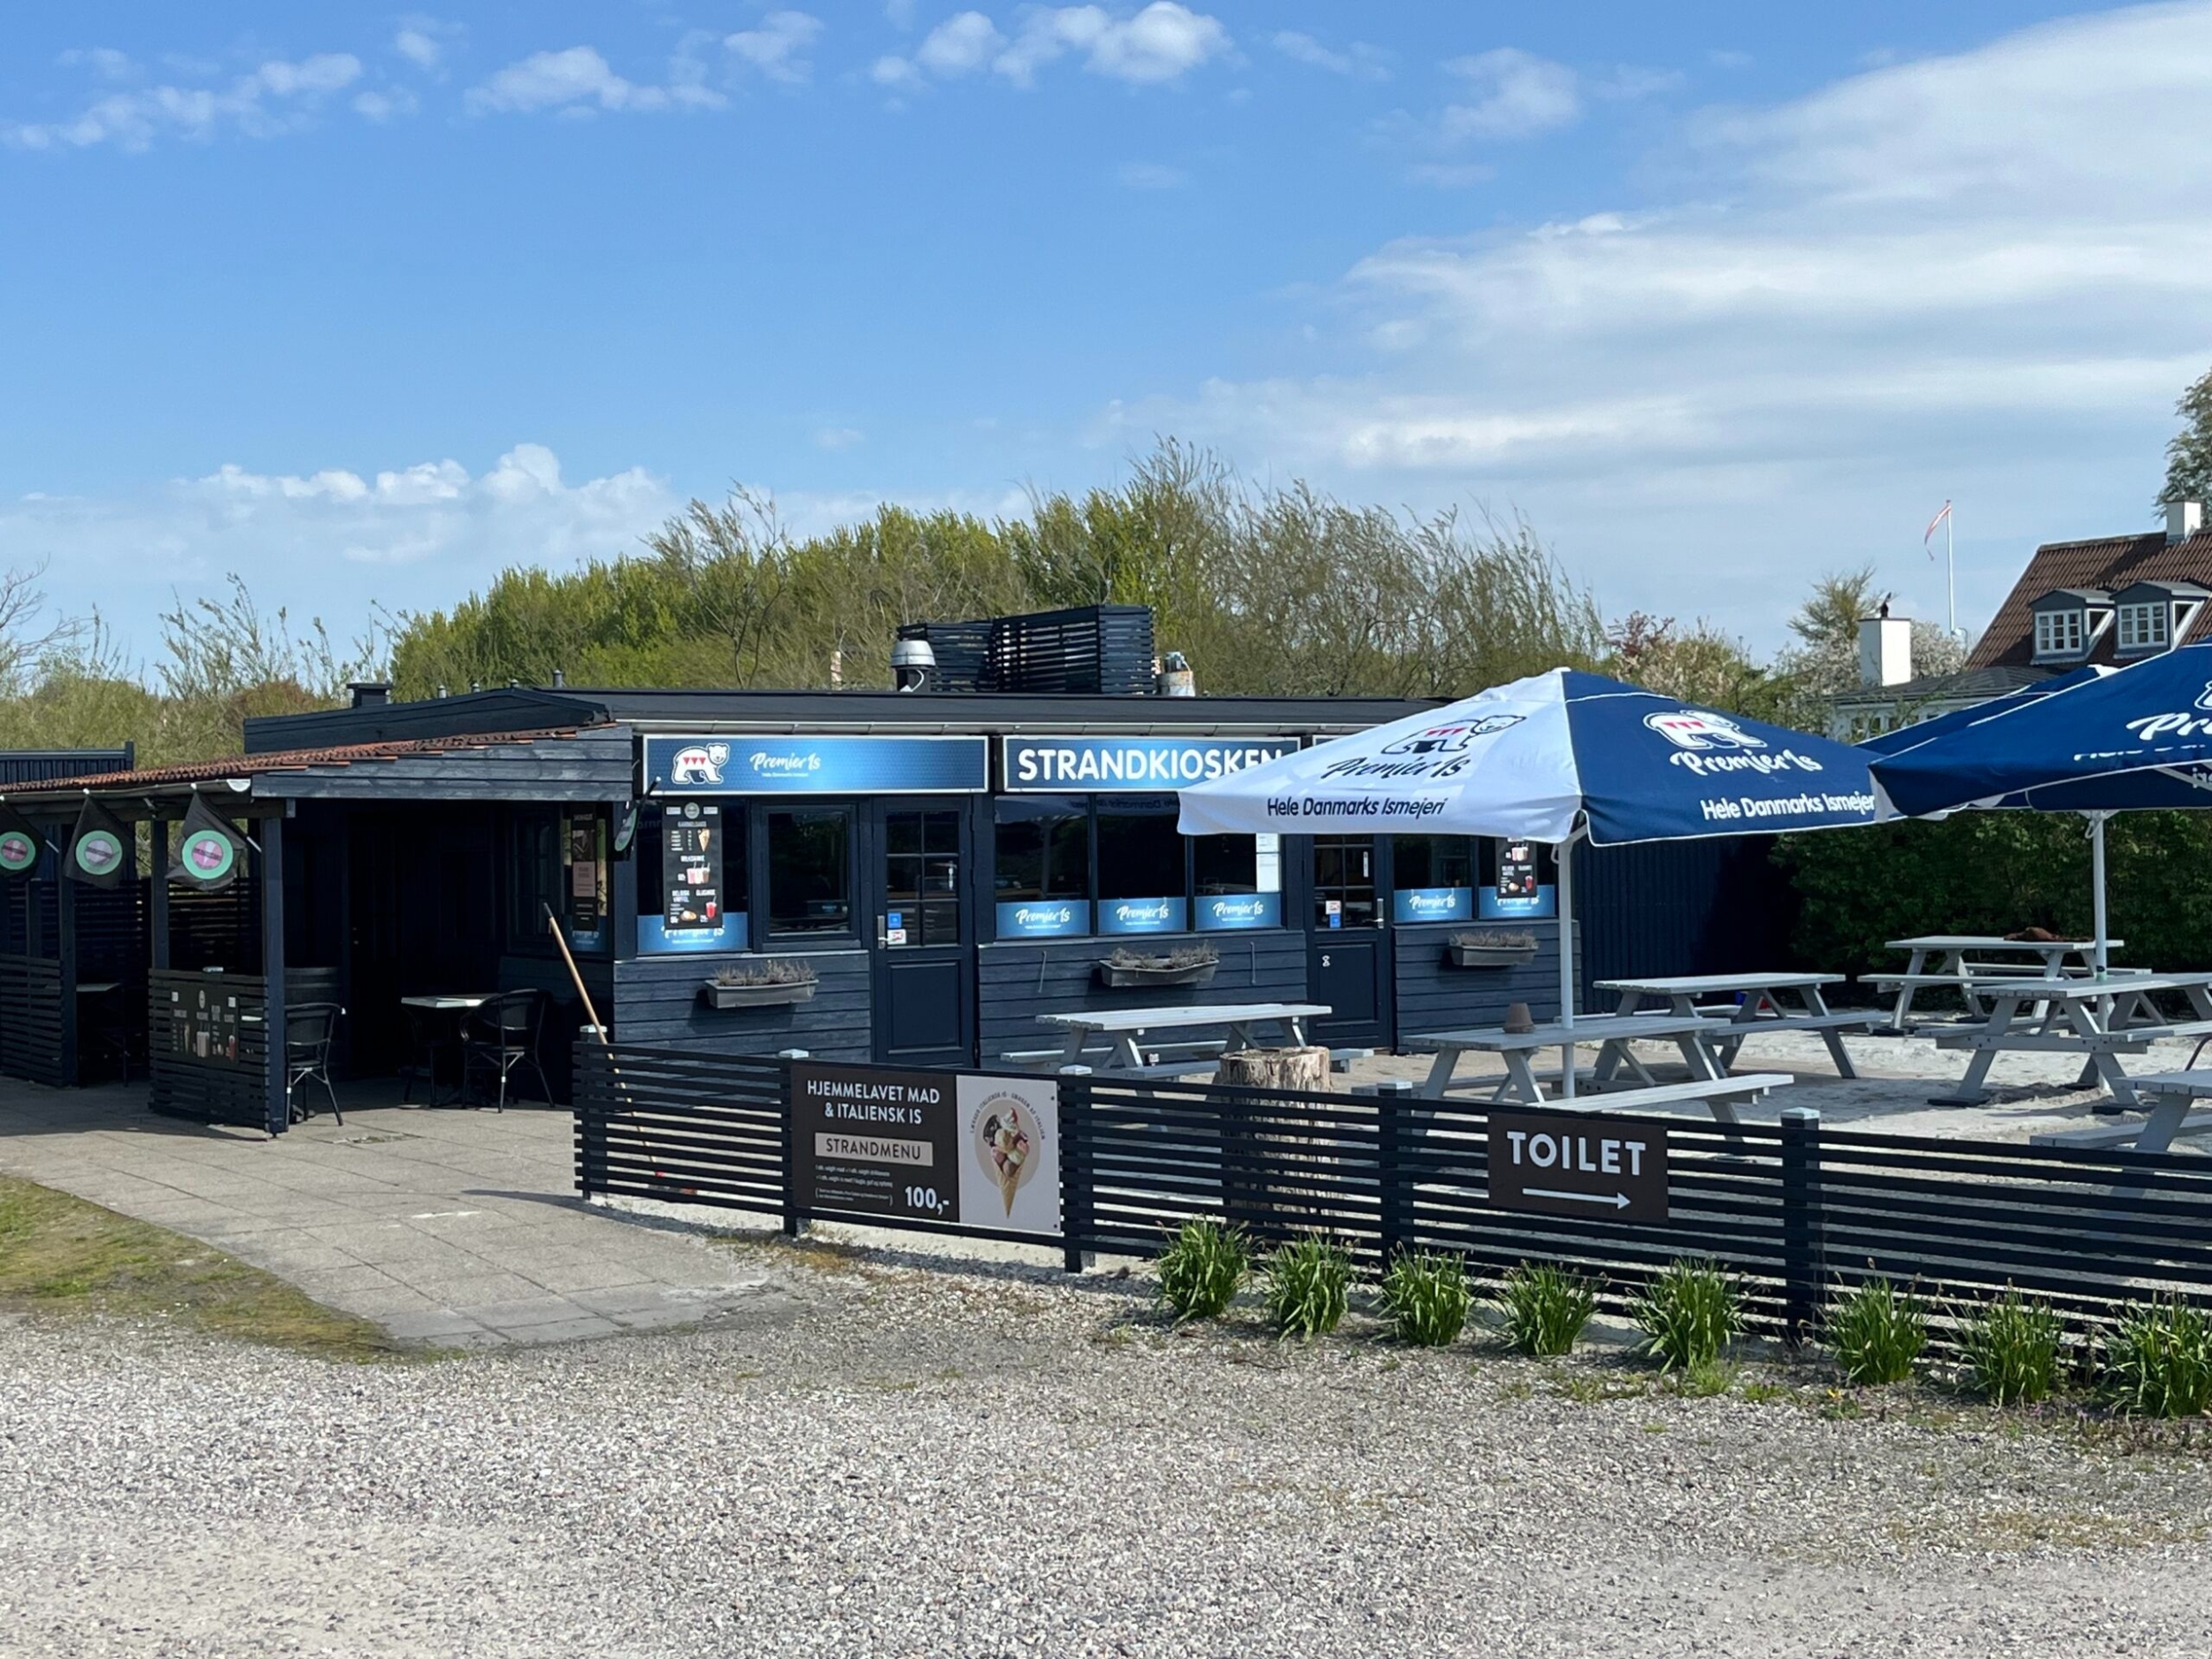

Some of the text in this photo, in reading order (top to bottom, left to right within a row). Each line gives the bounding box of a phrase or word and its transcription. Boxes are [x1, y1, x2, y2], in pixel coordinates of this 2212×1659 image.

[749, 752, 807, 771] Premier
[1320, 757, 1441, 780] Premier
[1669, 749, 1791, 776] Premier
[1267, 796, 1448, 819] Hele Danmarks Ismejeri
[1700, 791, 1875, 821] Hele Danmarks Ismejer
[807, 1079, 941, 1104] HJEMMELAVET MAD
[825, 1102, 922, 1125] & ITALIENSK IS
[826, 1137, 921, 1160] STRANDMENU
[1507, 1131, 1647, 1176] TOILET
[904, 1186, 950, 1216] 100,-
